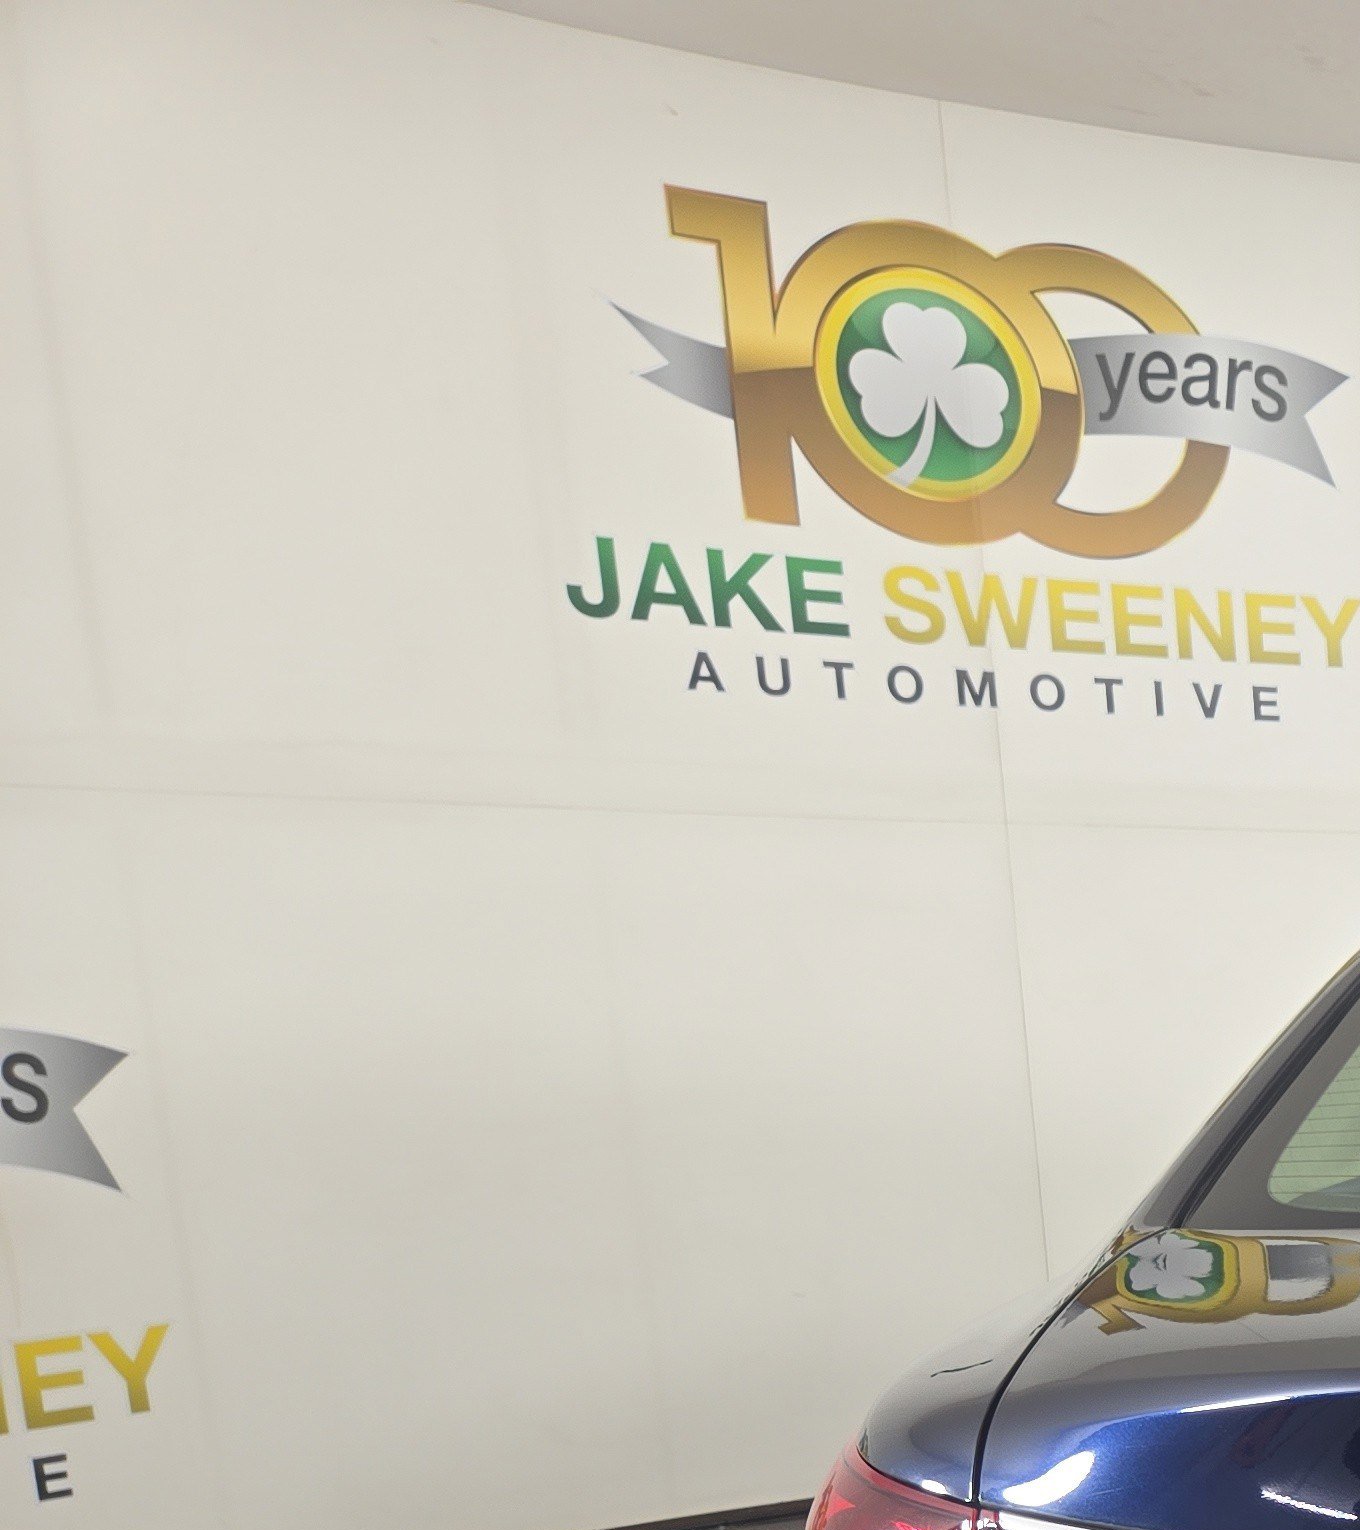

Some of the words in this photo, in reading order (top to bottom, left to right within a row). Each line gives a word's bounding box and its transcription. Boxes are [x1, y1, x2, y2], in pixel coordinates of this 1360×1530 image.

[664, 184, 1231, 560] 100
[1096, 351, 1289, 422] years
[566, 535, 851, 638] JAKE
[686, 651, 1282, 722] AUTOMOTIVE
